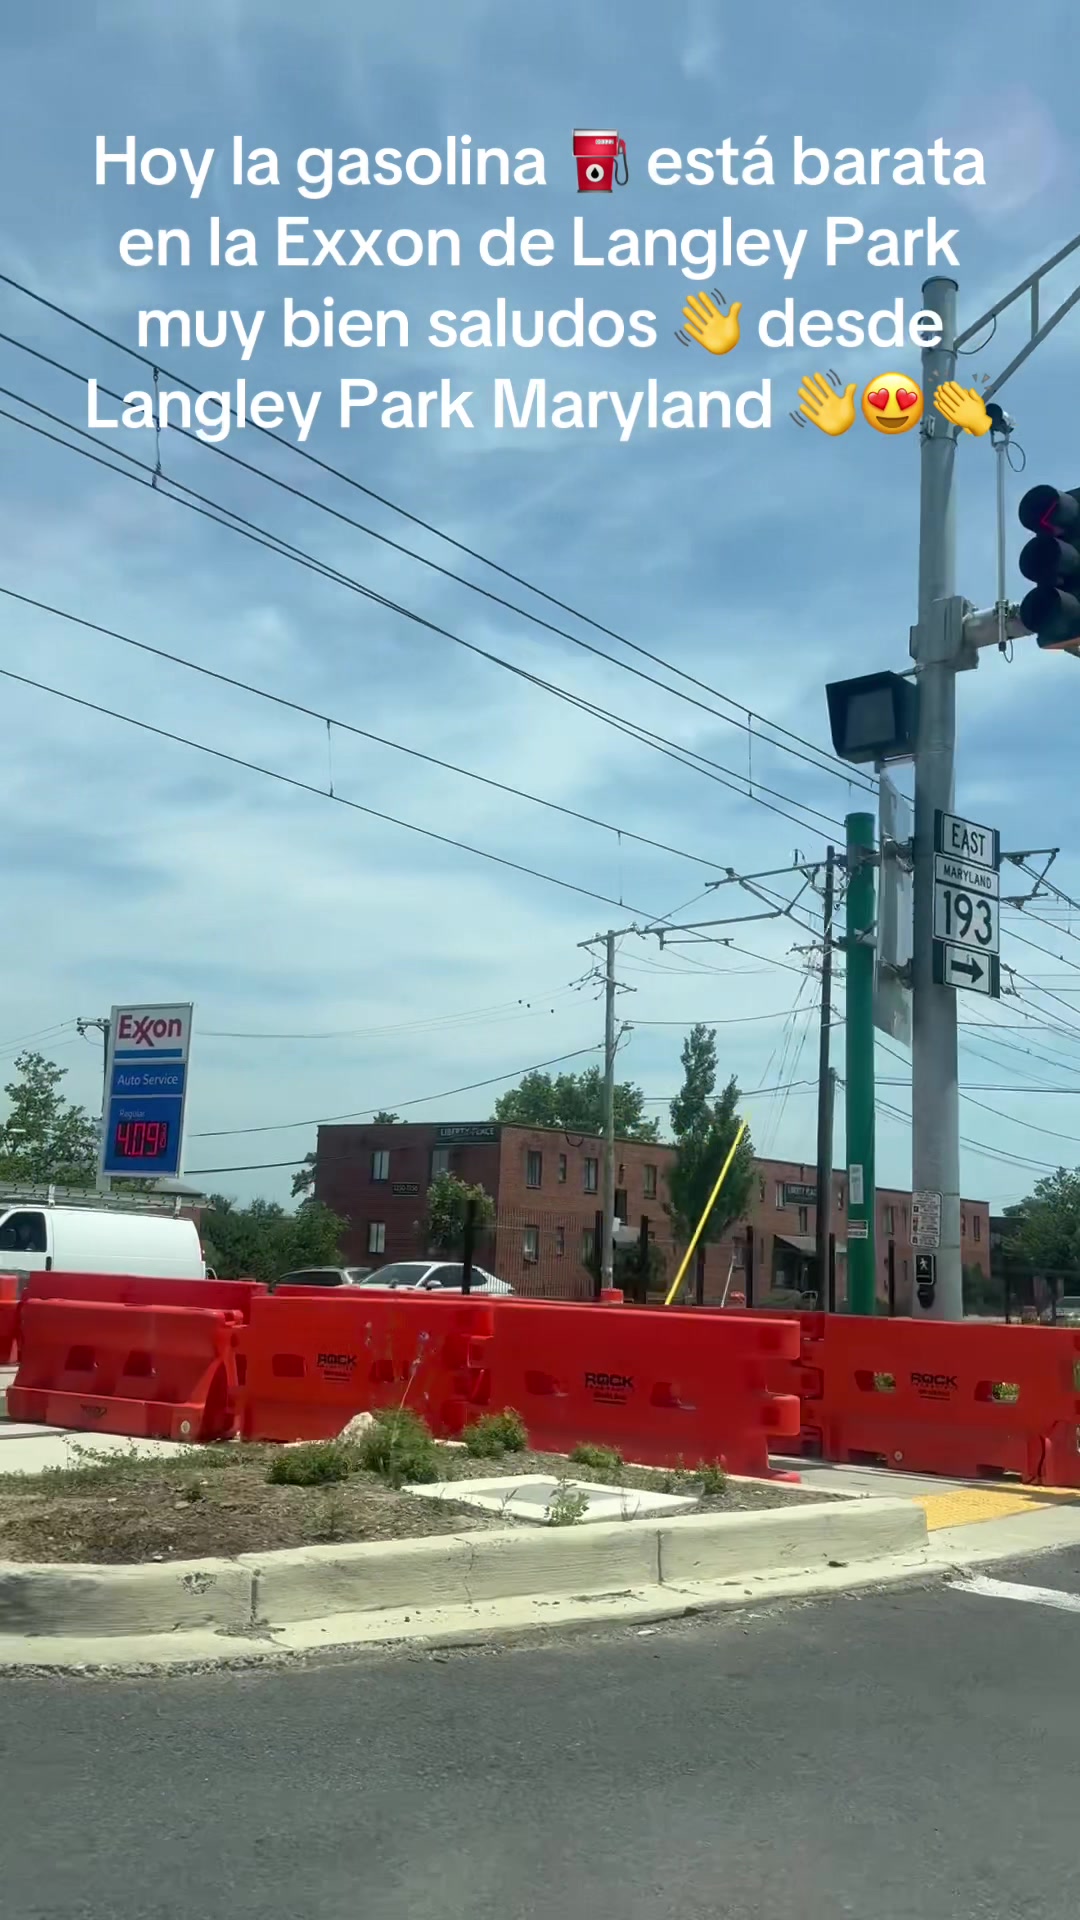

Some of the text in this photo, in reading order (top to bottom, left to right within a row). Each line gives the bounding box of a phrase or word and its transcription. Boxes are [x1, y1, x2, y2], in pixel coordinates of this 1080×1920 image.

[952, 823, 986, 856] EAST
[943, 864, 993, 890] MARYLAND
[943, 889, 993, 946] 193
[118, 1014, 182, 1047] Exxon
[117, 1073, 179, 1086] Auto Service
[317, 1353, 358, 1367] ROCK
[584, 1372, 634, 1389] ROCK
[911, 1372, 958, 1390] ROCK
